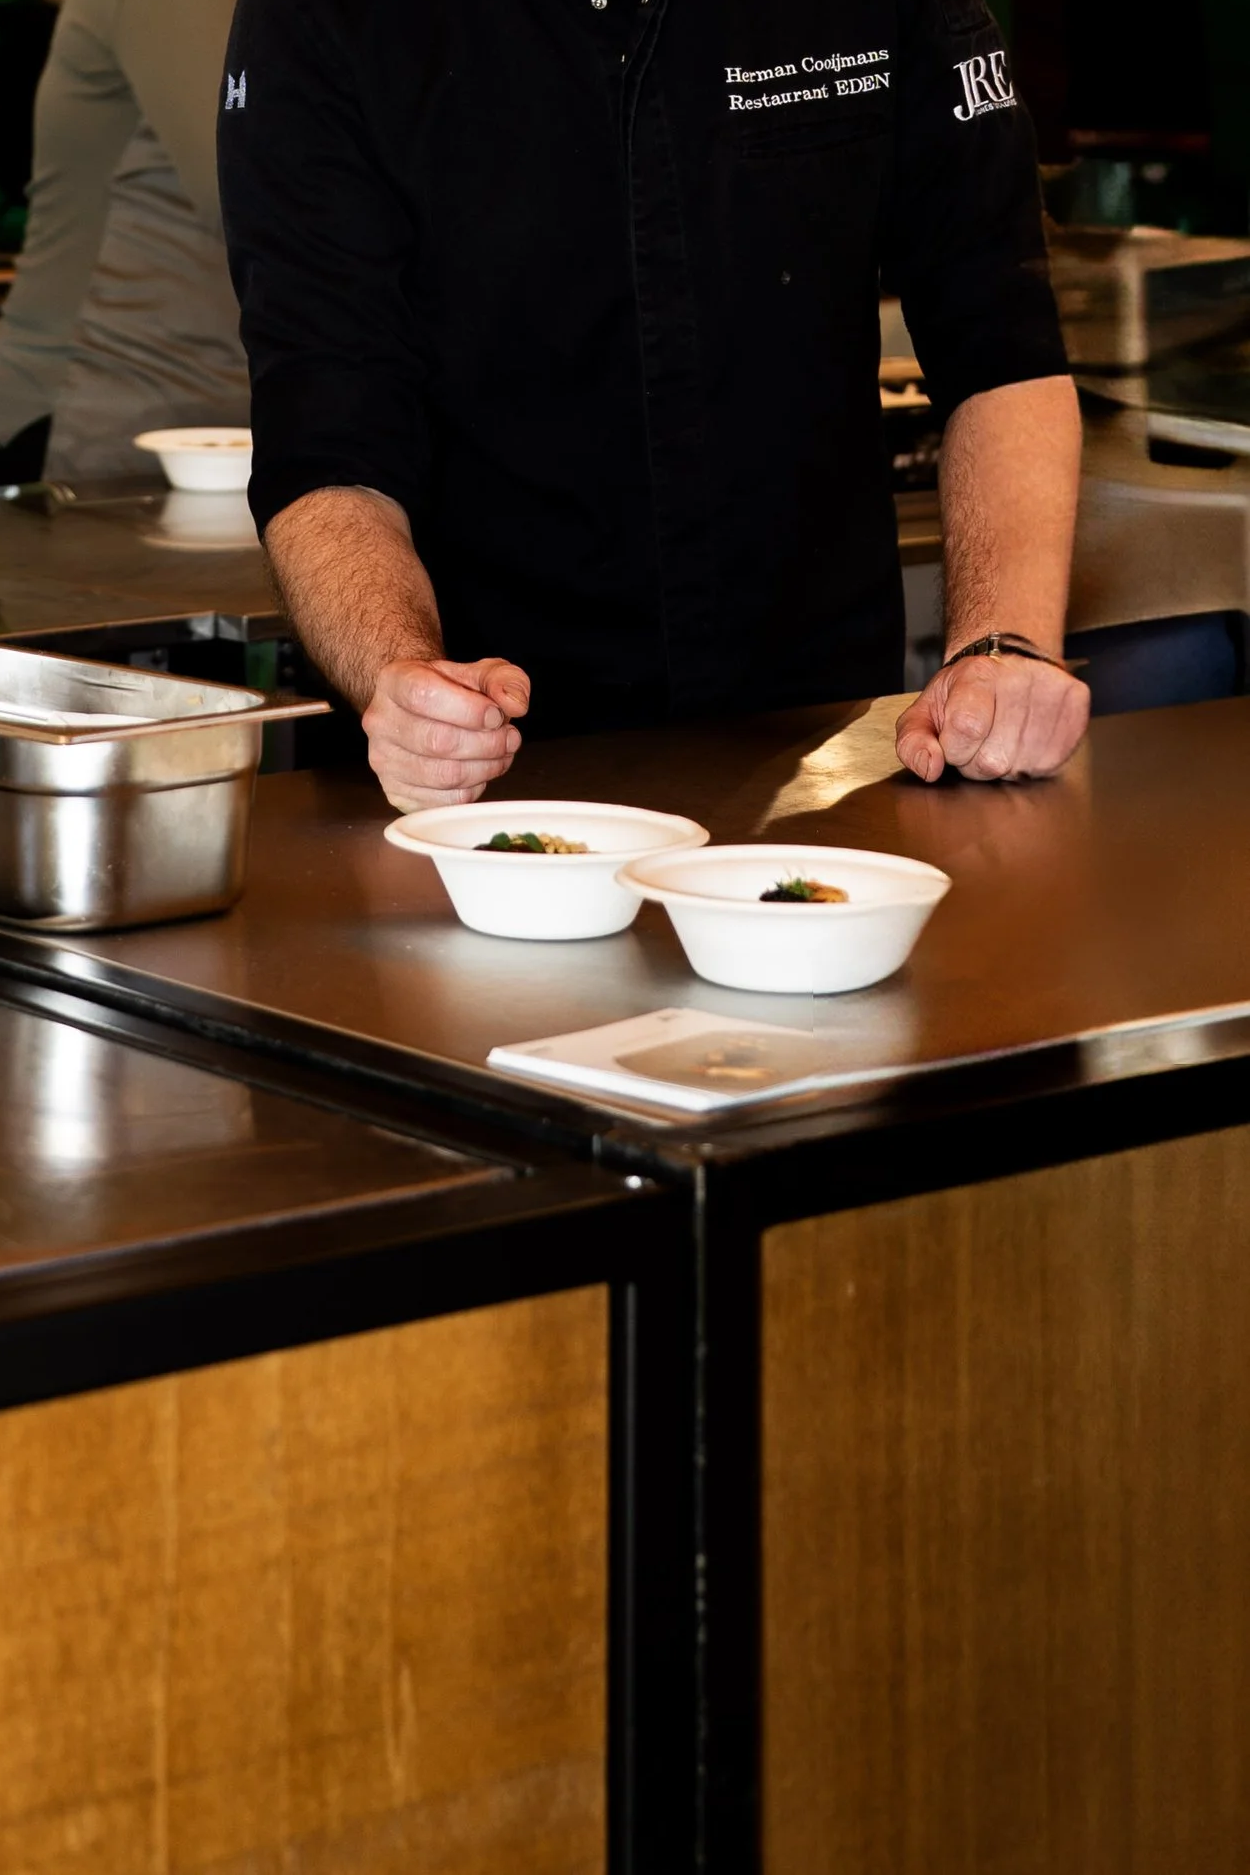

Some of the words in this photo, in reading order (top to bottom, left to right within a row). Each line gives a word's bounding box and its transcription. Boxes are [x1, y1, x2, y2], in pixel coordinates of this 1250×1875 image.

[724, 63, 798, 83] Herman
[801, 48, 890, 73] Cooijmans
[728, 83, 830, 111] Restaurant
[834, 72, 891, 96] EDEN
[953, 51, 1015, 121] JRE
